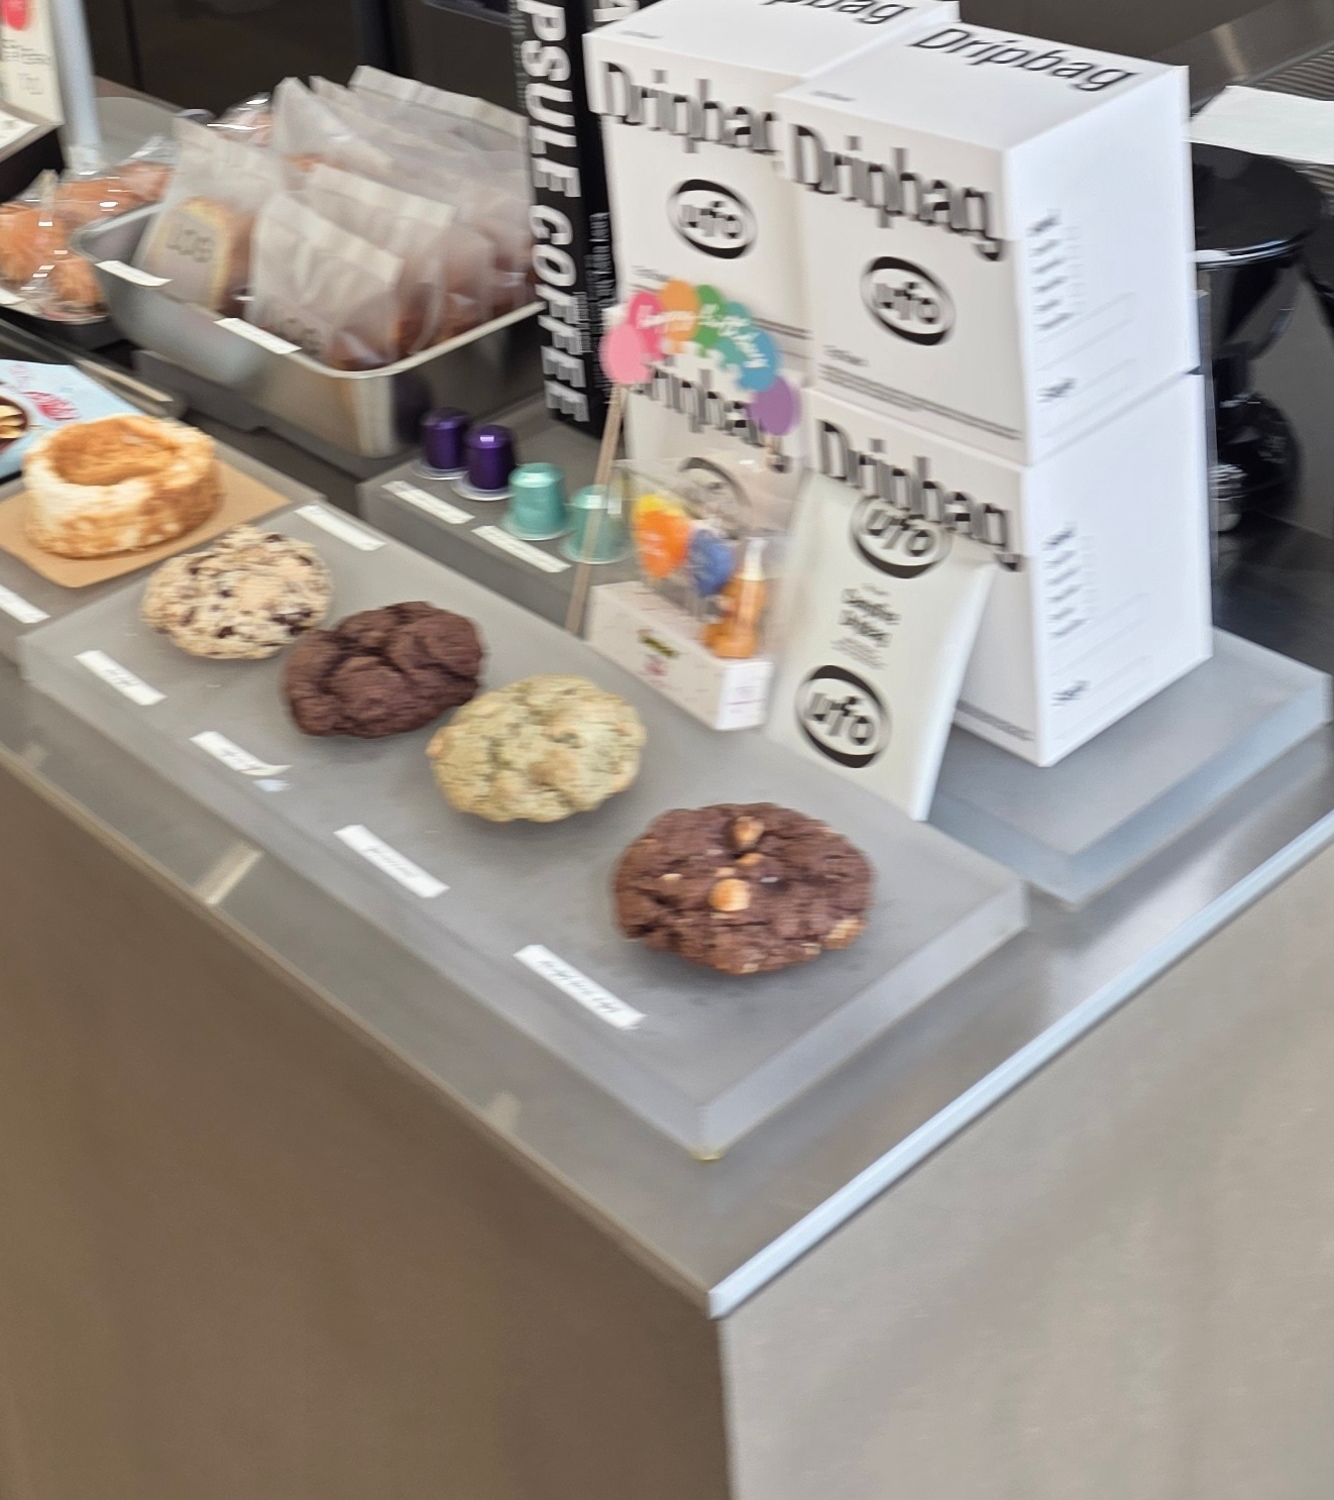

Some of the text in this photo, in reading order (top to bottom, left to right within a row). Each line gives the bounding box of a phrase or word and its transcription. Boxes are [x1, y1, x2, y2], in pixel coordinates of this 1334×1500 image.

[908, 27, 1137, 92] Dripbag
[789, 123, 1008, 261] Dripbag
[529, 204, 591, 422] COFFEE
[817, 419, 1025, 572] Dripbag
